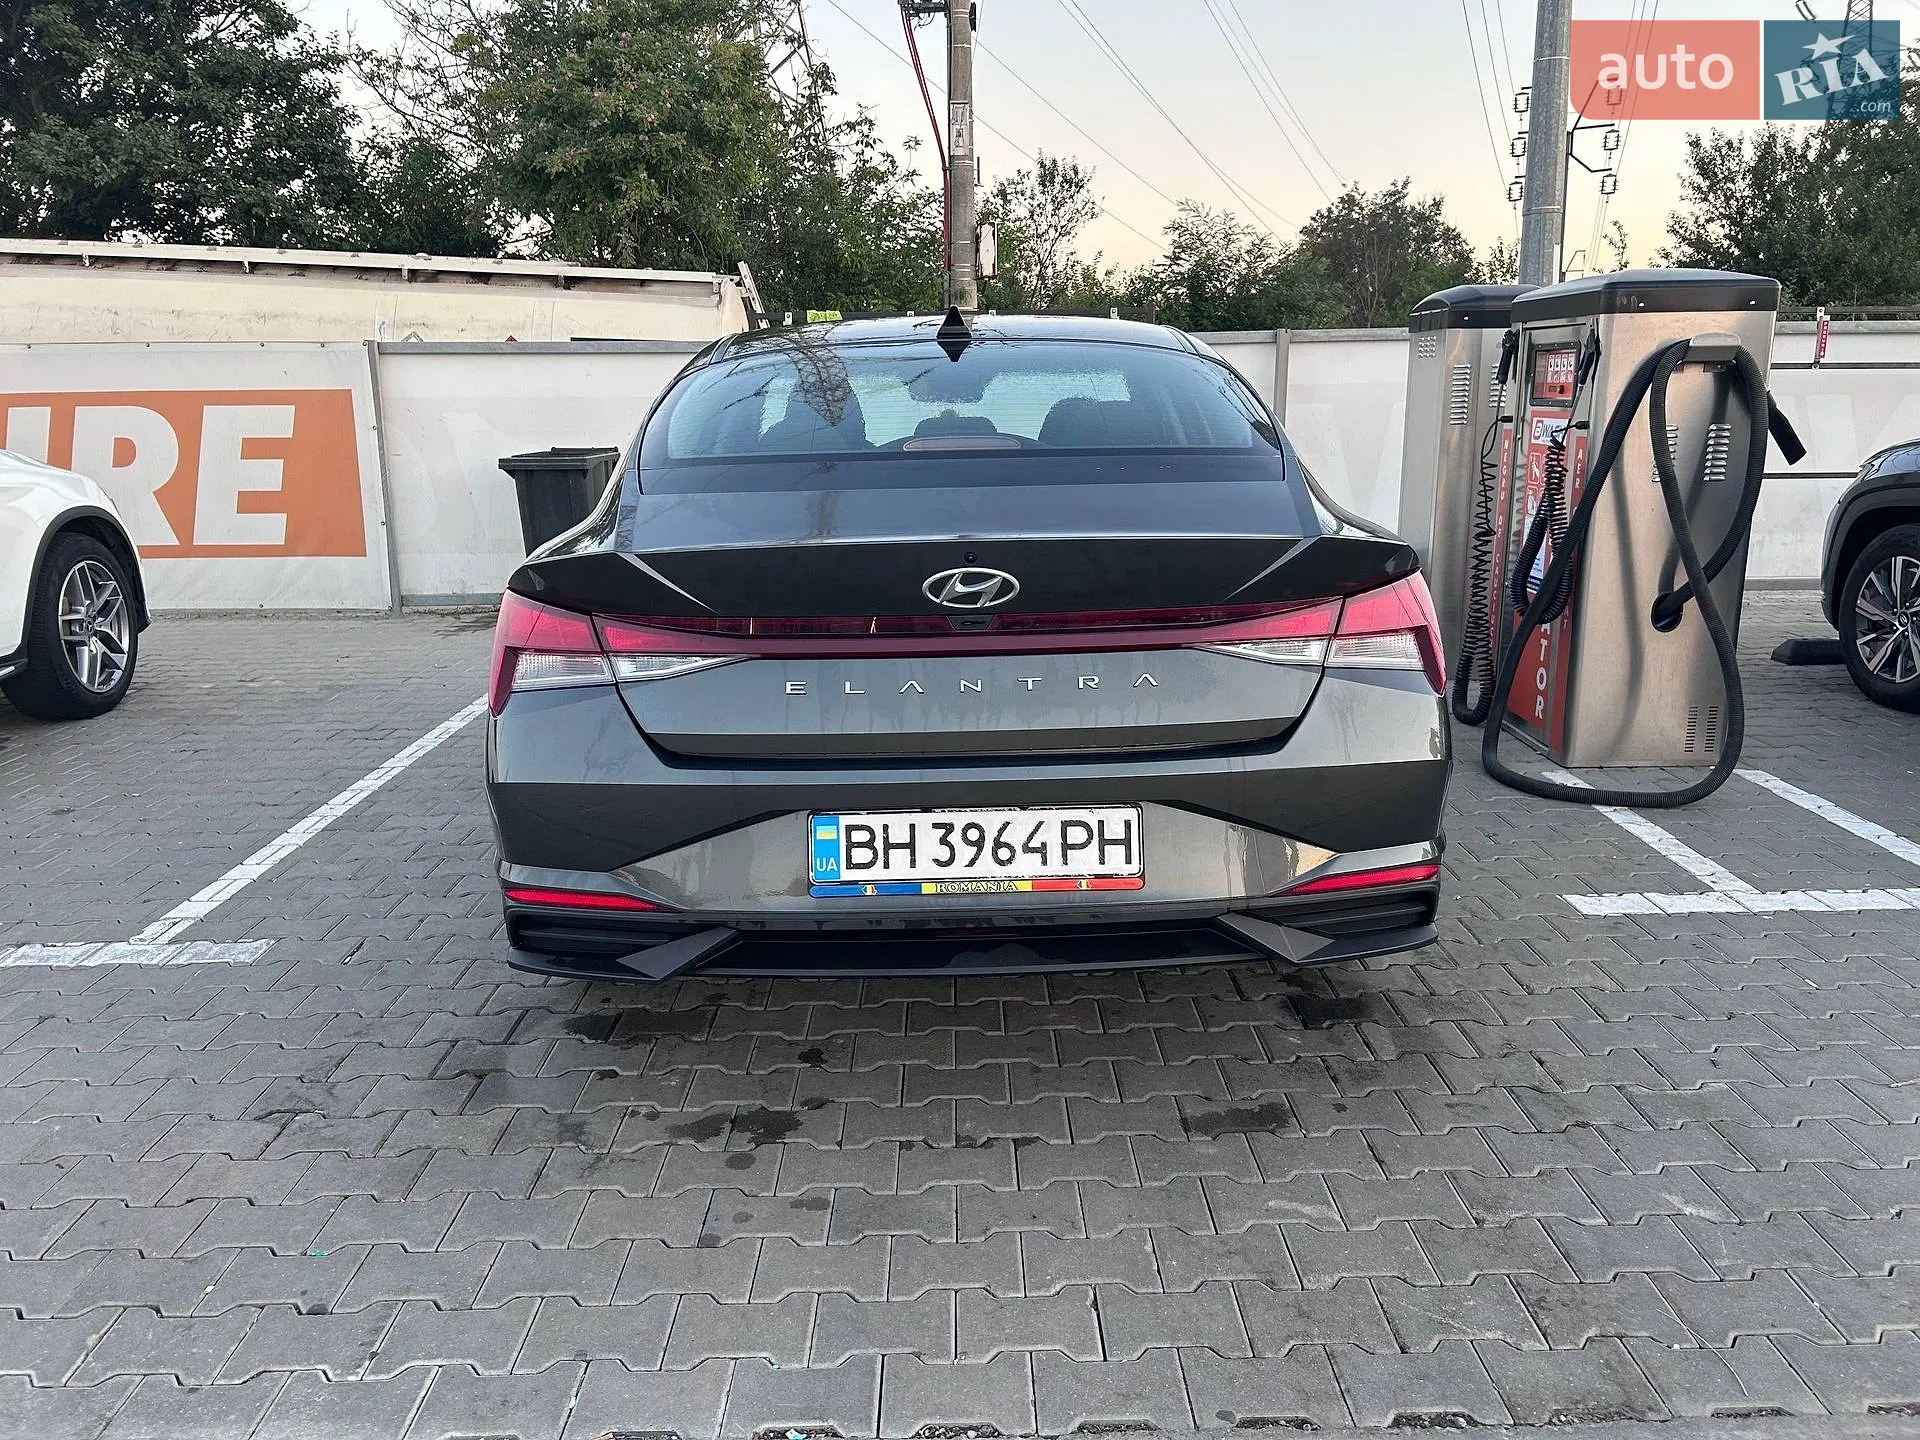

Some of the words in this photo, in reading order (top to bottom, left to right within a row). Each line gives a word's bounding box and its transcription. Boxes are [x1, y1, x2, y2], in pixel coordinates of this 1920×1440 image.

[1574, 448, 1584, 489] AER
[785, 673, 1159, 695] ELANTRA
[844, 823, 917, 869] BH
[931, 820, 1048, 868] 3964
[1059, 818, 1132, 866] PH
[816, 857, 838, 872] UA
[934, 880, 1020, 893] ROMANIA
